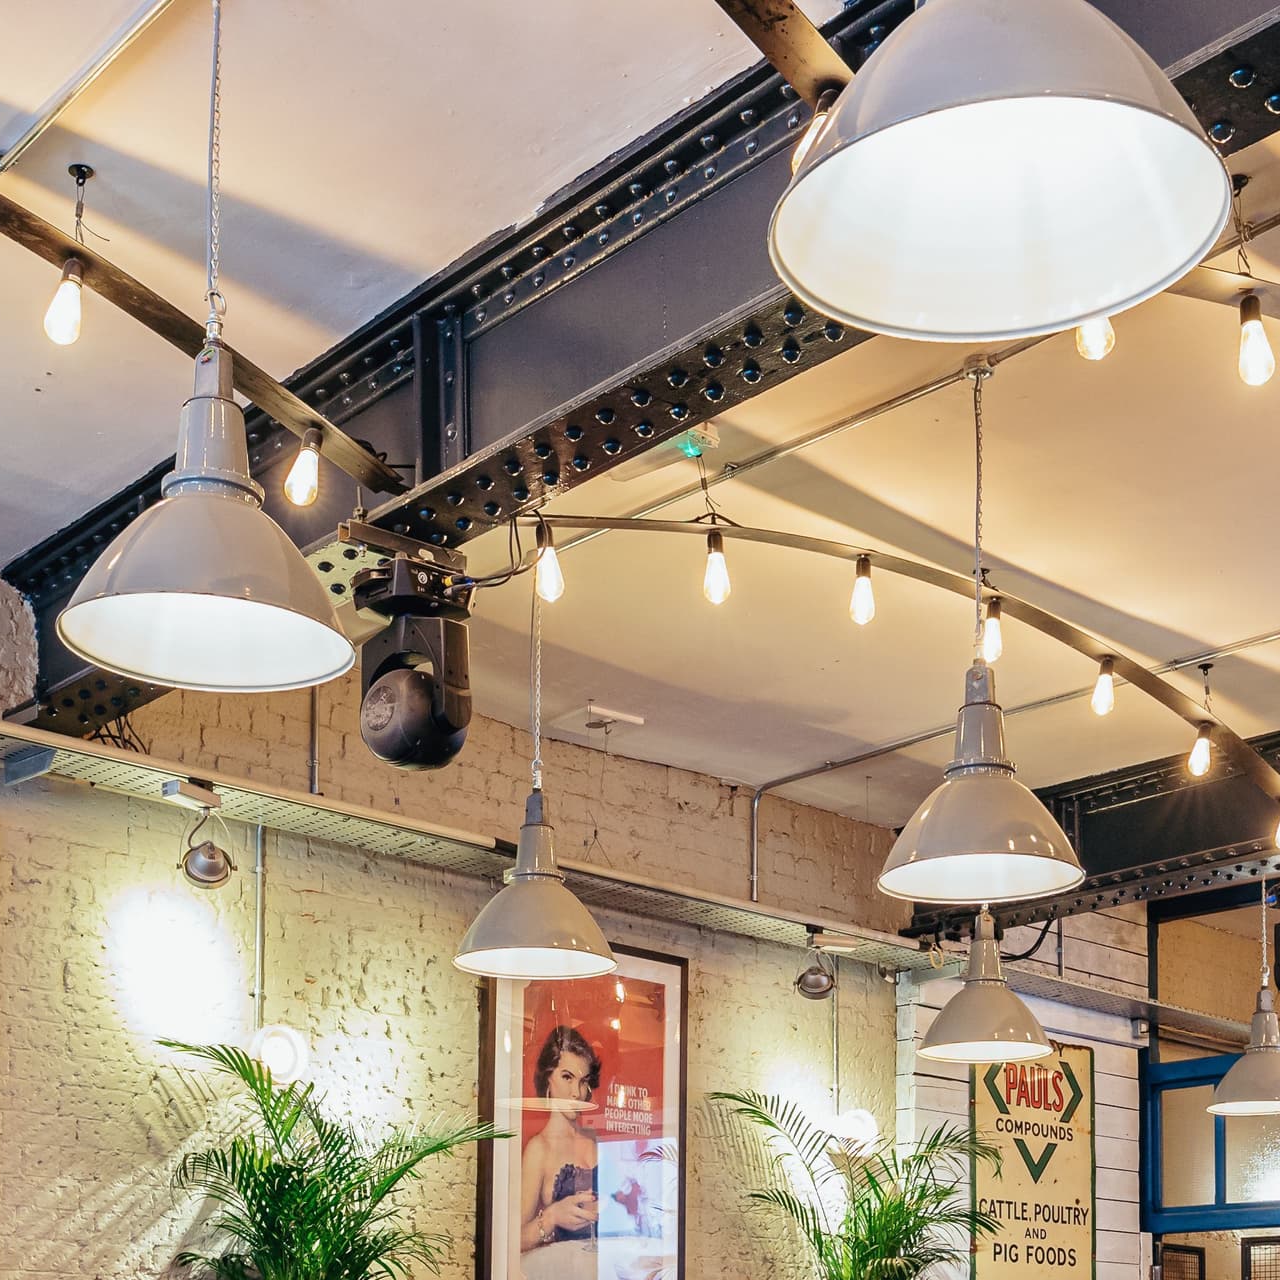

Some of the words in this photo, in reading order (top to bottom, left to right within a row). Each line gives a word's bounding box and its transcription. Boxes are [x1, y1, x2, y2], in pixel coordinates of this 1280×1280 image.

[638, 1087, 649, 1098] TO
[1005, 1062, 1064, 1112] PAULS
[604, 1107, 632, 1121] PEOPLE
[632, 1111, 653, 1125] MORE
[606, 1120, 651, 1137] INTERESTING
[995, 1118, 1074, 1141] COMPOUNDS
[1034, 1203, 1089, 1226] POULTRY
[1024, 1227, 1047, 1240] AND
[993, 1242, 1019, 1263] PIG
[1026, 1245, 1077, 1267] FOODS
